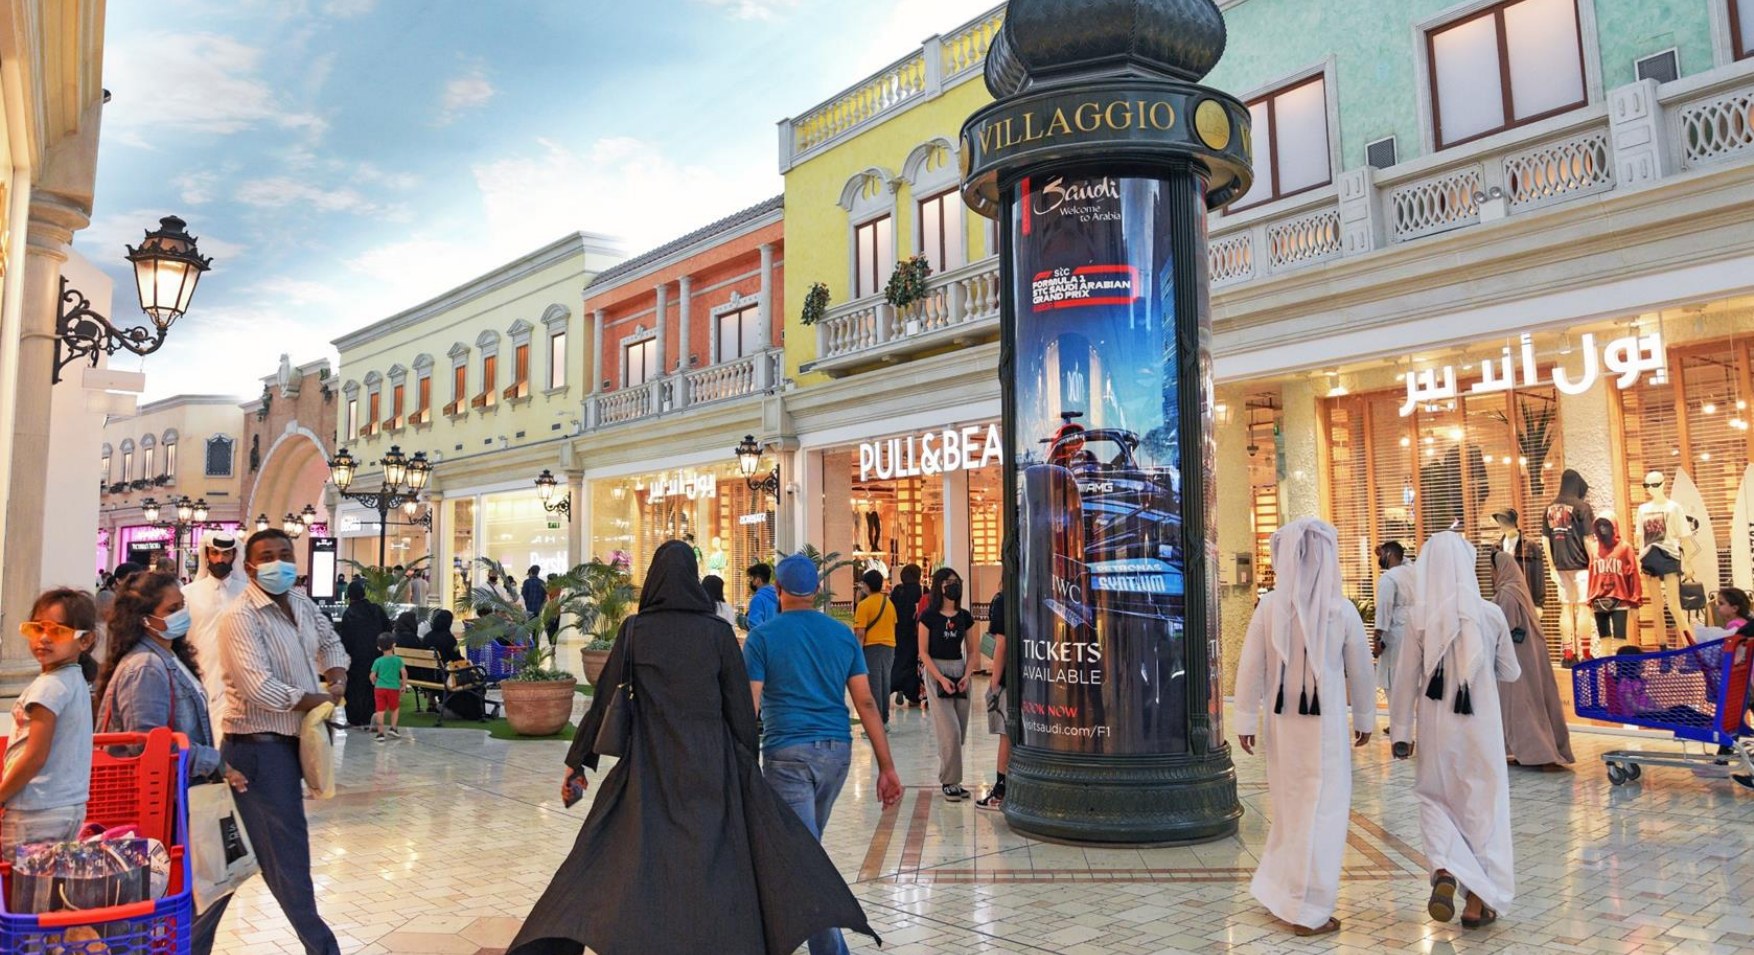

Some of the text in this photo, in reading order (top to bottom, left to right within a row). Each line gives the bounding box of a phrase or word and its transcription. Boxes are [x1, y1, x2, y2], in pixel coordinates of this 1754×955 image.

[979, 101, 1176, 156] VILLAGGIO
[1034, 176, 1120, 215] Saudi
[1060, 206, 1101, 216] Welcome
[1080, 212, 1121, 222] to Arabia
[1032, 275, 1086, 289] FORMULA 1
[1032, 280, 1131, 297] STC SAUDI ARABIAN
[1032, 290, 1090, 304] GRAND PRIX
[1085, 482, 1114, 493] AMG
[1097, 563, 1162, 572] PETRONAS
[1052, 574, 1081, 604] IWC
[1098, 574, 1166, 592] SYNTIUM
[1023, 639, 1102, 663] TICKETS
[1023, 665, 1102, 685] AVAILABLE
[1047, 704, 1078, 718] NOW
